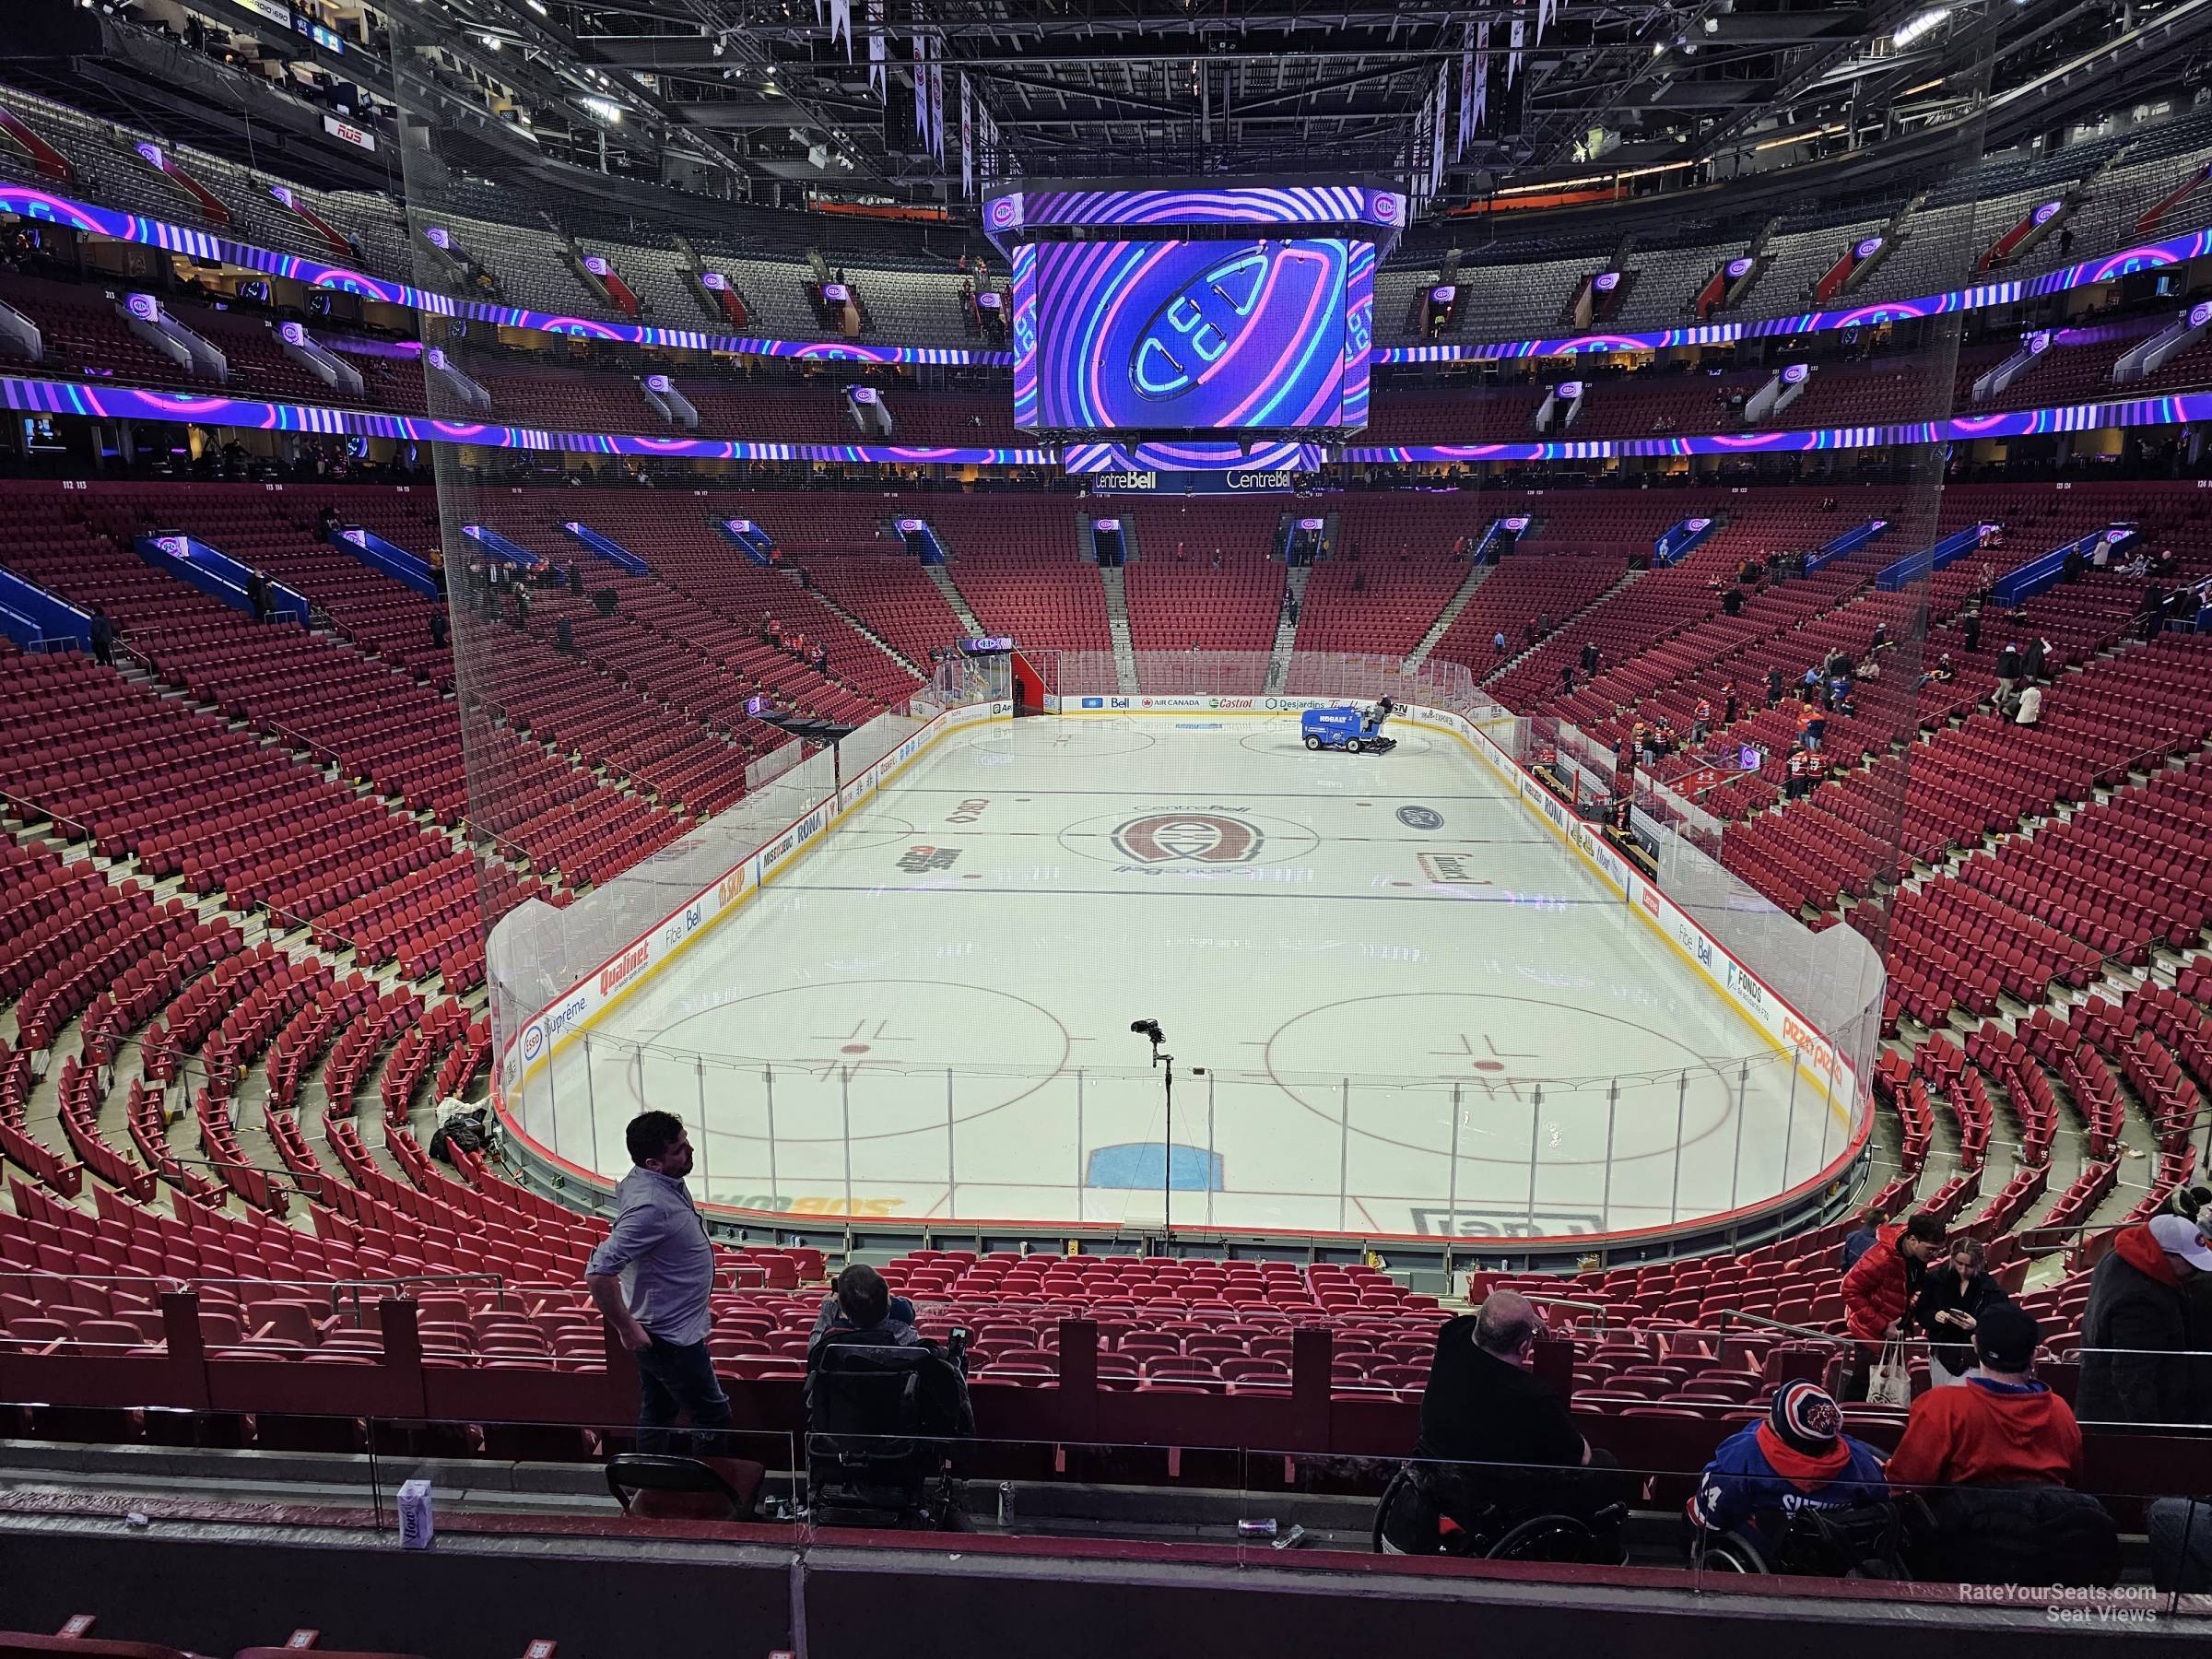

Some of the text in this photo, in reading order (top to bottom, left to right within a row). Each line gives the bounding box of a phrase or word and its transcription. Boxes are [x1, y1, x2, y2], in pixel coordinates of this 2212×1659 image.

[62, 480, 87, 489] 112 113
[1226, 470, 1290, 488] CentreBell
[1111, 698, 1130, 709] Bell
[1219, 699, 1253, 709] Castrol
[1280, 700, 1325, 710] Desjardins
[1319, 715, 1347, 724] KOBALT
[797, 811, 822, 844] RONA
[1433, 856, 1475, 879] intact
[665, 902, 701, 947] Fibe Bell
[1679, 924, 1712, 969] Fibe Bell
[600, 940, 650, 995] Qualinet
[1738, 971, 1762, 1004] FONDS
[1783, 1017, 1842, 1088] pizza pizza
[213, 1193, 221, 1201] FF
